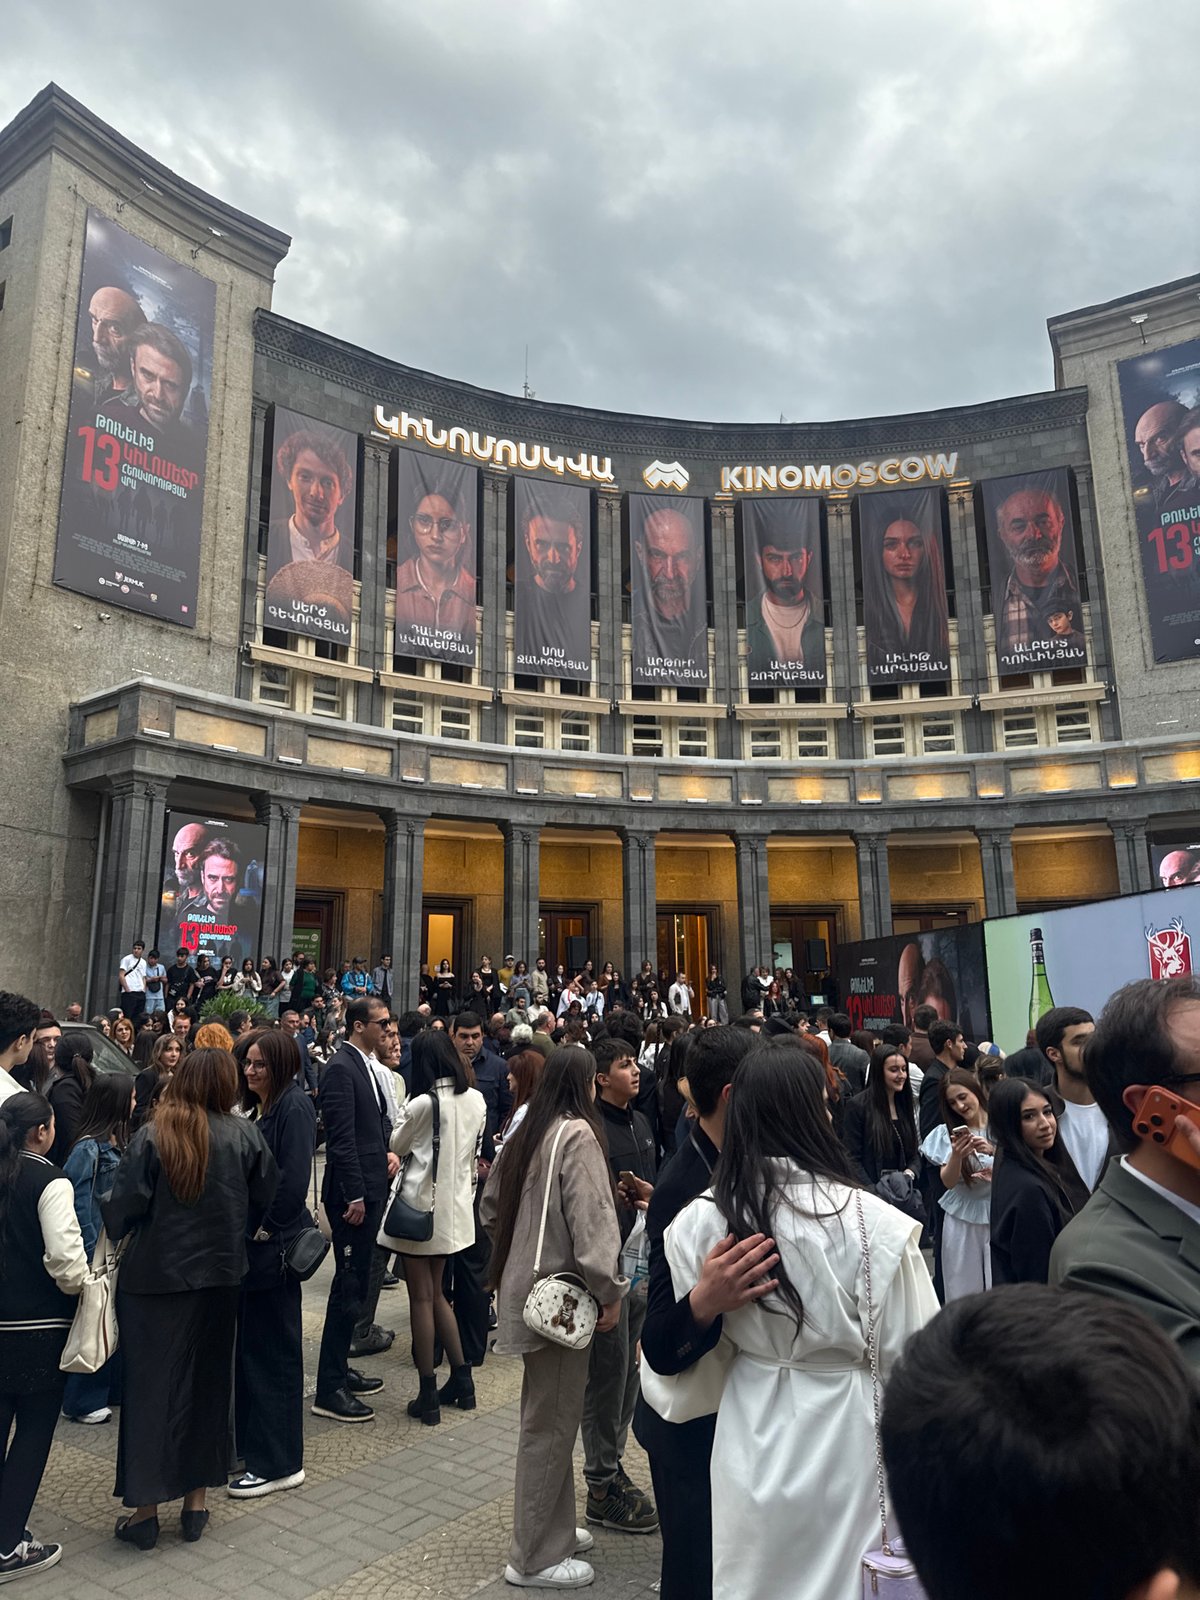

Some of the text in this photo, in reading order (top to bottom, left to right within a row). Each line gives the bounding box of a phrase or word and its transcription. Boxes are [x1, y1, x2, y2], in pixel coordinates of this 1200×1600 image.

[95, 413, 155, 452] ԹՈՒՆԵԼԻՑ
[78, 425, 121, 492] 13
[123, 443, 199, 490] ԿԻԼՈՄԵՏՐ
[121, 475, 137, 490] ՎՐԱ
[721, 452, 958, 491] KINOMOSCOW
[1147, 523, 1193, 574] 13
[292, 599, 328, 617] ՍԵՐԺ
[268, 605, 349, 635] ԳԵՎՈՐԳՅԱՆ
[399, 633, 474, 655] ԱՎԱՆԵՍՅԱՆ
[542, 646, 565, 658] ՍՈՍ
[1014, 638, 1068, 653] ԱԼԲԵՐՏ
[516, 654, 589, 671] ՋԱՆԻԲԵԿՅԱՆ
[647, 656, 695, 668] ԱՐԹՈՒՐ
[886, 651, 931, 664] ԼԻԼԻԹ
[179, 921, 200, 951] 13
